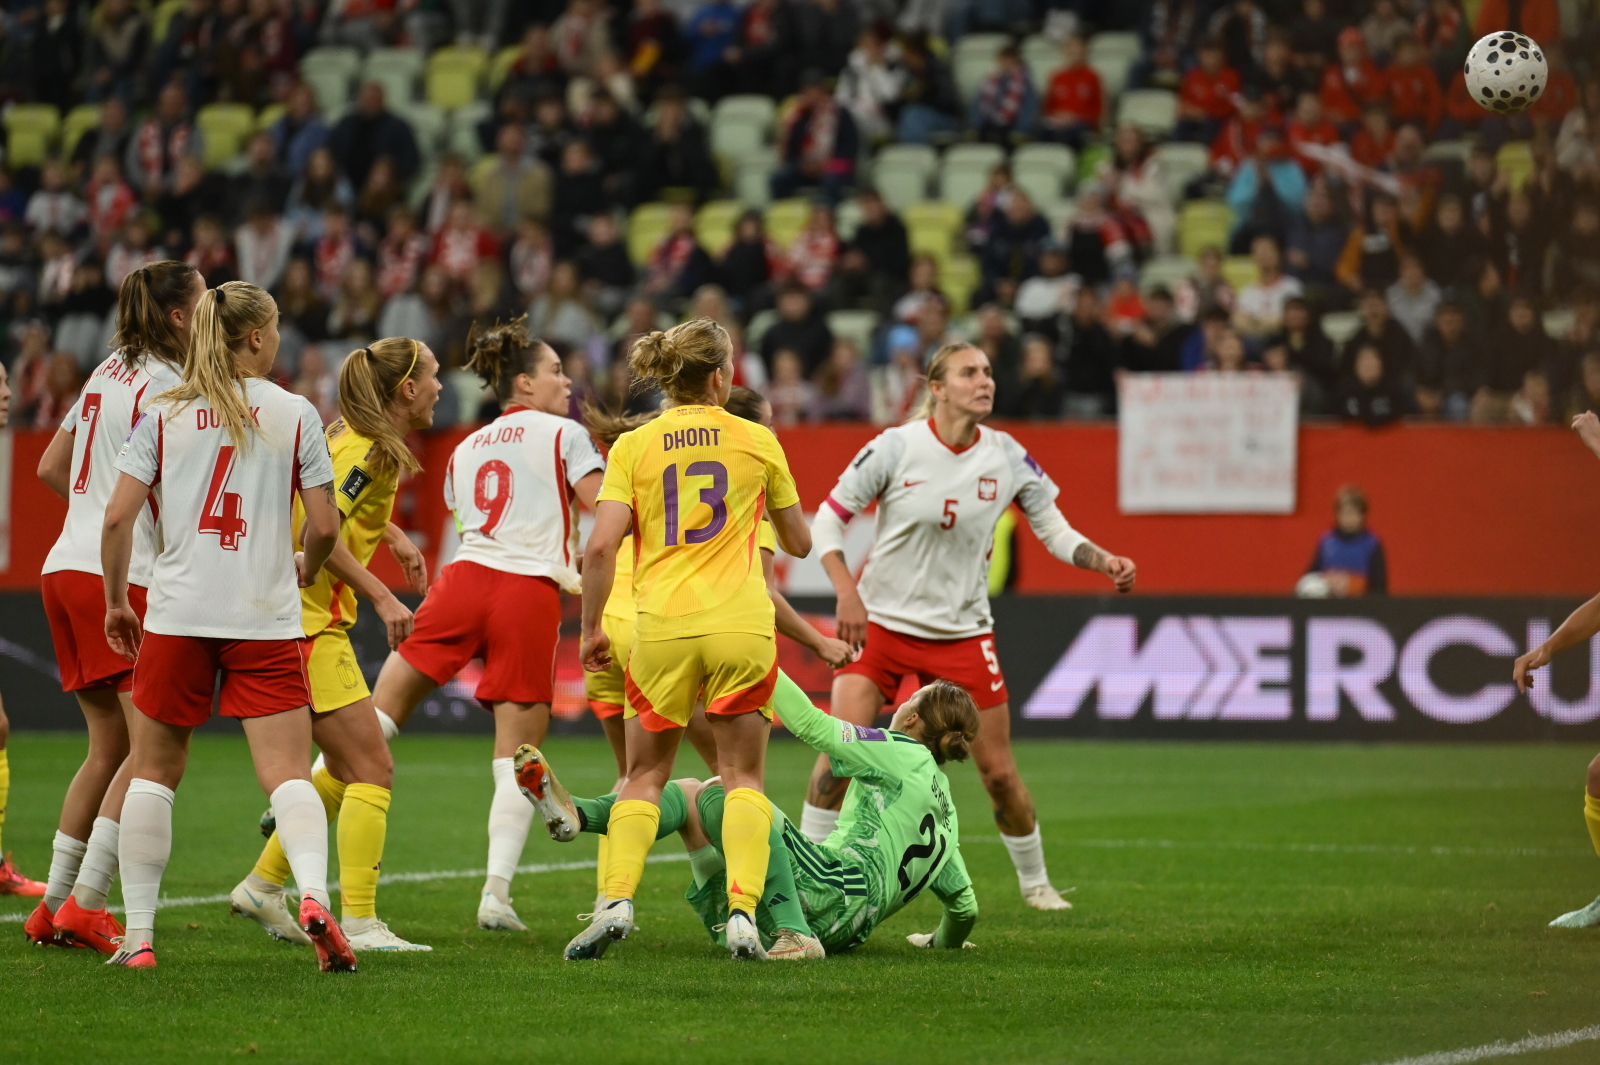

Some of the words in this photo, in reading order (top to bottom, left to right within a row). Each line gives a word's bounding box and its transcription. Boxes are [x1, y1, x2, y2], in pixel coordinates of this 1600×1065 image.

[73, 393, 102, 494] 7
[196, 406, 261, 431] DUK
[473, 427, 525, 449] PAJOR
[663, 427, 721, 452] DHONT
[197, 445, 247, 551] 4
[474, 458, 515, 541] 9
[663, 460, 729, 547] 13
[940, 499, 959, 530] 5
[980, 639, 1000, 675] 5
[1022, 615, 1600, 725] MERCU
